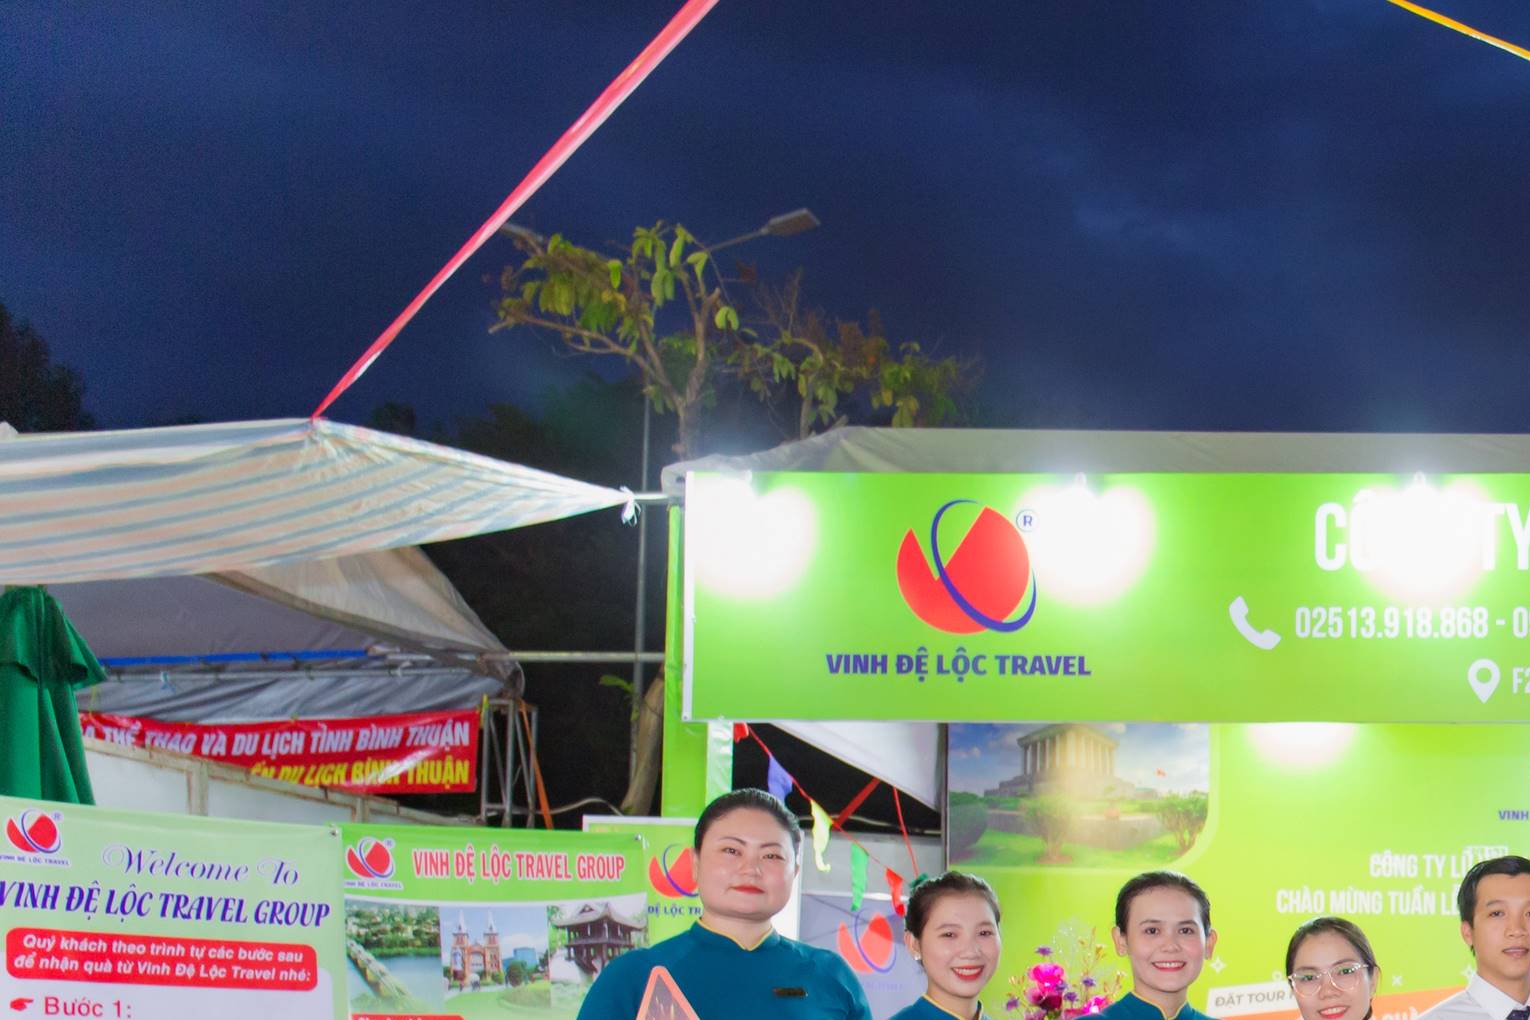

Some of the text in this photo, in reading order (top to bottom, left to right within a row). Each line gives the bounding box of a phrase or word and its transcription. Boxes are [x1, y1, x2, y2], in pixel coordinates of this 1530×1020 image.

[1295, 607, 1488, 638] 02513.918.868
[826, 647, 1091, 682] VINH ĐỆ LỘC TRAVEL
[201, 733, 227, 756] VÀ
[232, 735, 258, 756] DU
[262, 733, 304, 761] LỊCH
[356, 724, 402, 750] BÌNH
[406, 719, 469, 751] THUẬN
[405, 758, 468, 789] THUẬN
[1498, 810, 1529, 820] VINH
[102, 844, 249, 881] Welcome
[258, 860, 299, 885] To
[413, 845, 625, 884] VINH ĐỆ LỘC TRAVEL GROUP
[1370, 851, 1446, 878] CÔNG TY
[0, 880, 331, 927] VINH ĐỆ LỘC TRAVEL GROUP
[1276, 884, 1437, 913] CHÀO MỪNG TUẦN
[44, 996, 132, 1018] Bước 1:
